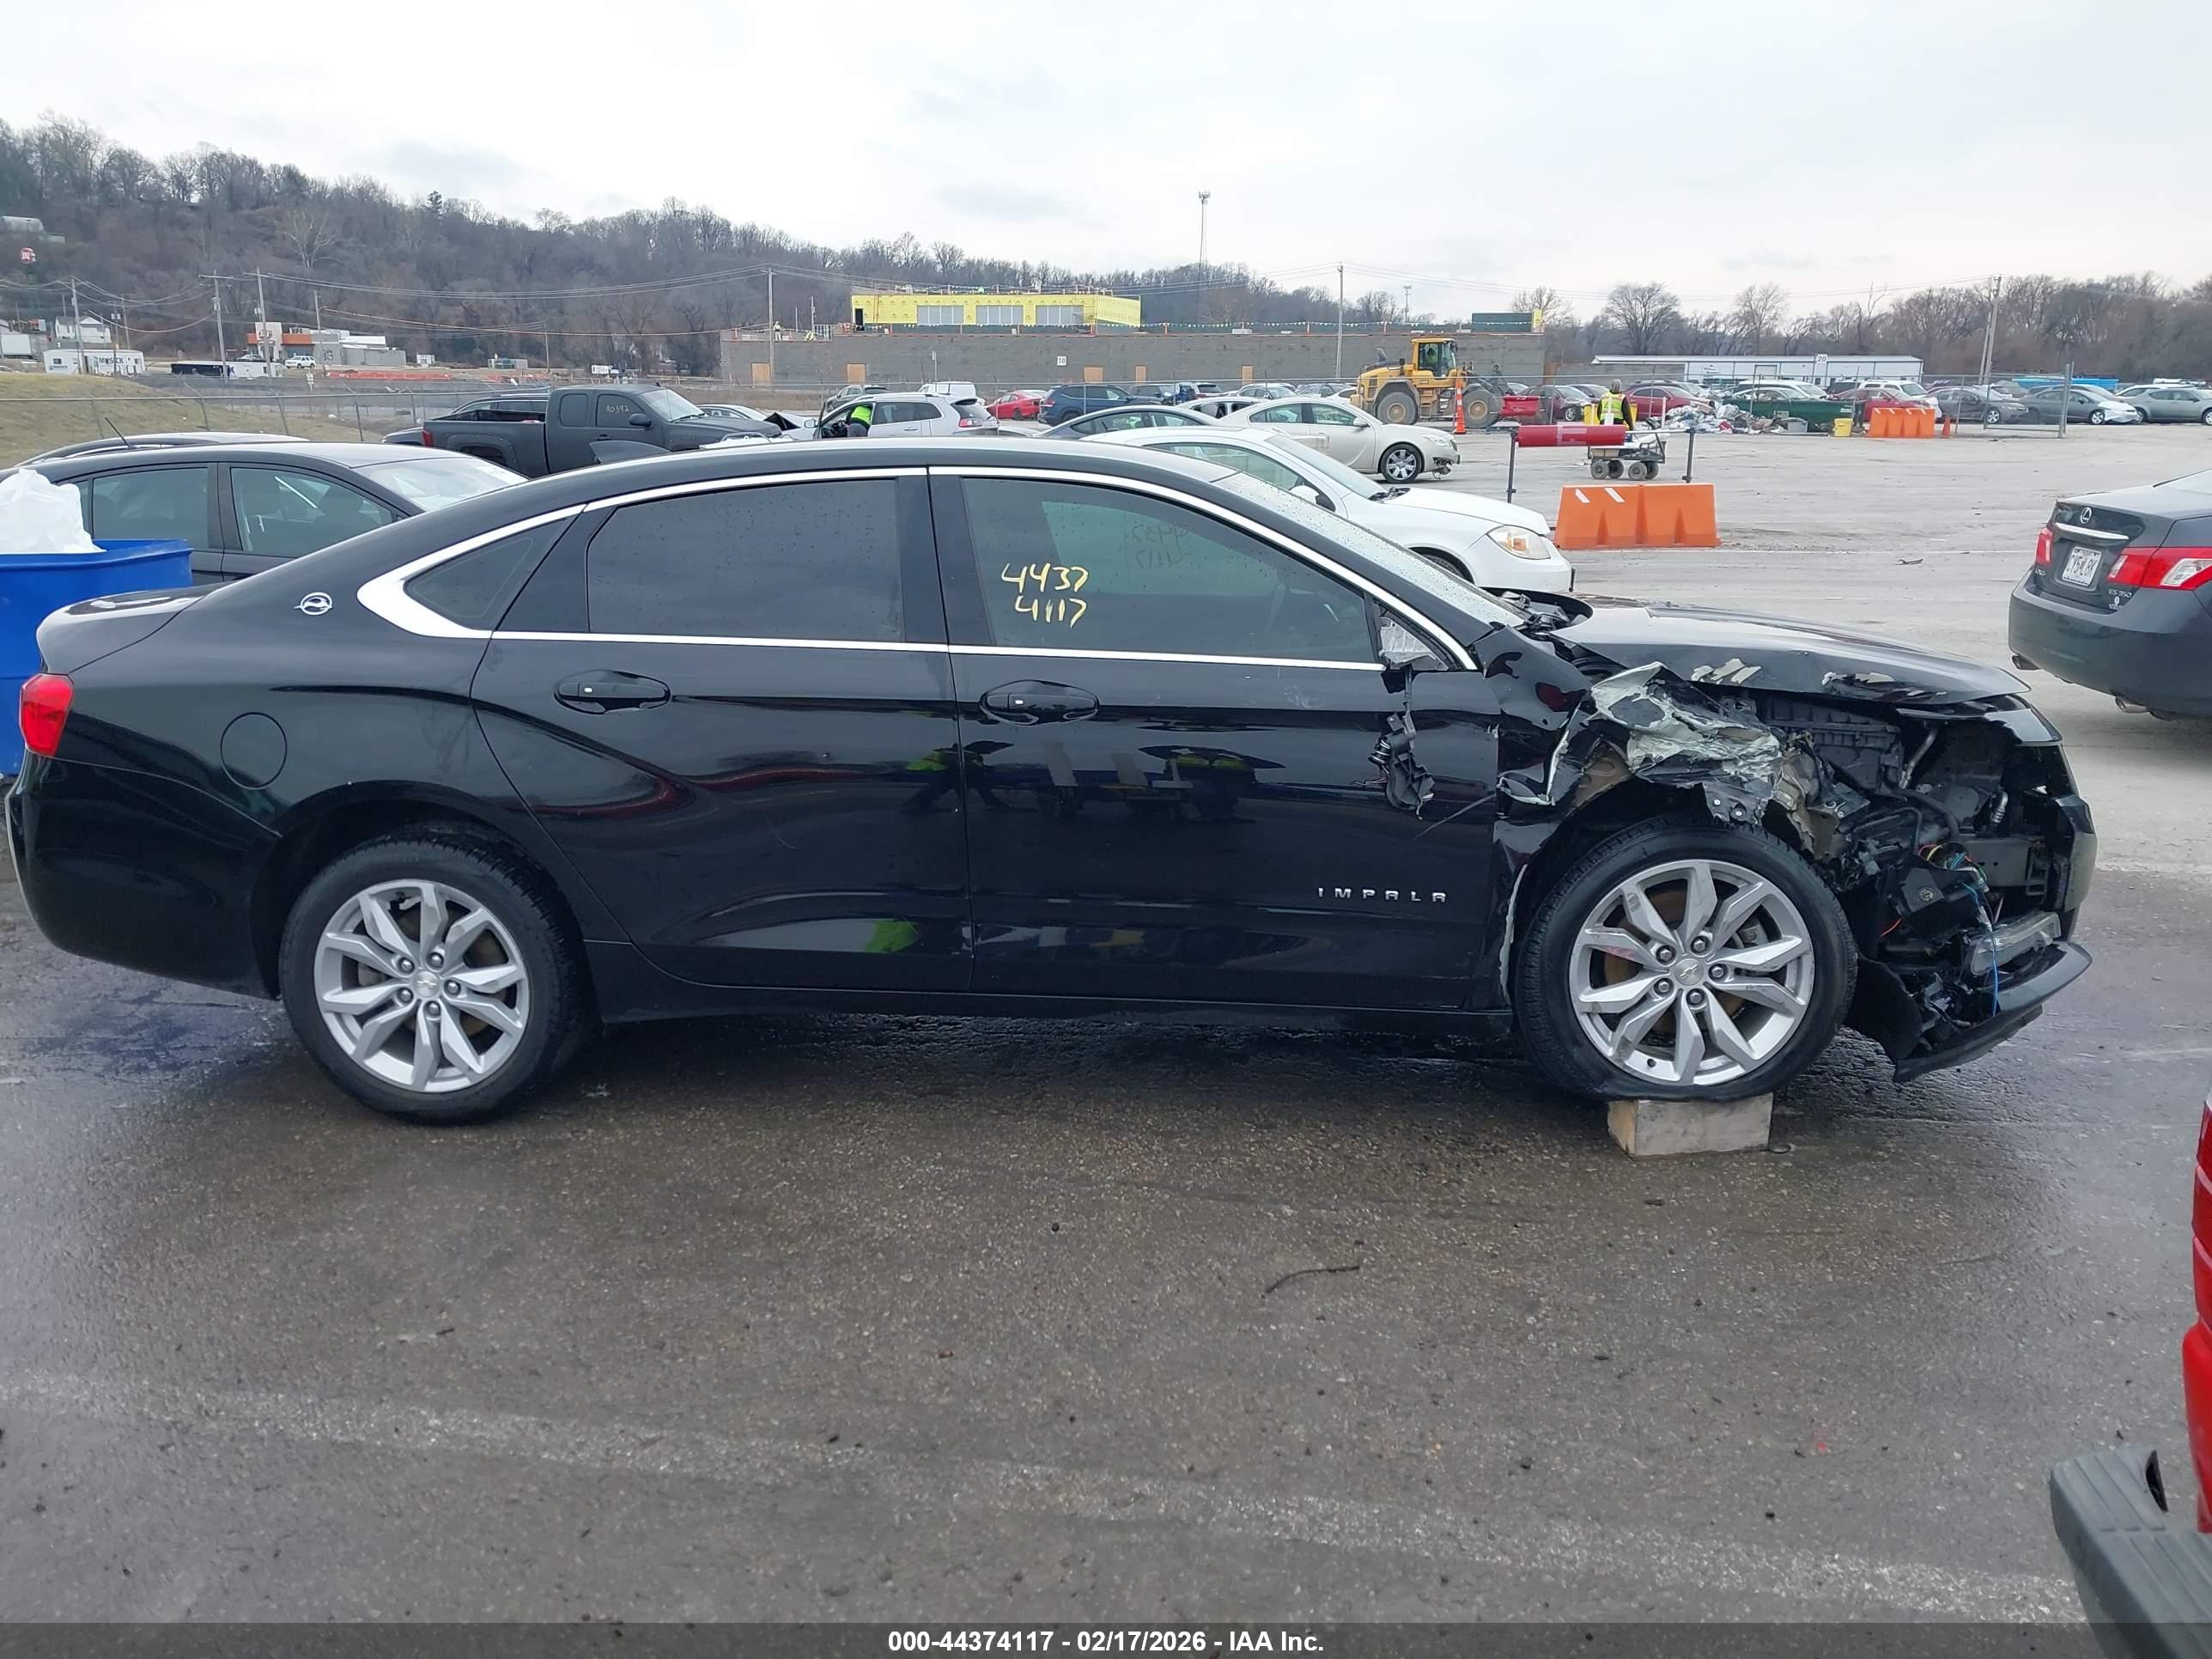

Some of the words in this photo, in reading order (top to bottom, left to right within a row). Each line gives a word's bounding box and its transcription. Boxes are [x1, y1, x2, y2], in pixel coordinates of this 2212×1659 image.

[1000, 562, 1089, 593] 4437
[1015, 595, 1087, 629] 4117
[1317, 887, 1446, 903] IMPALA
